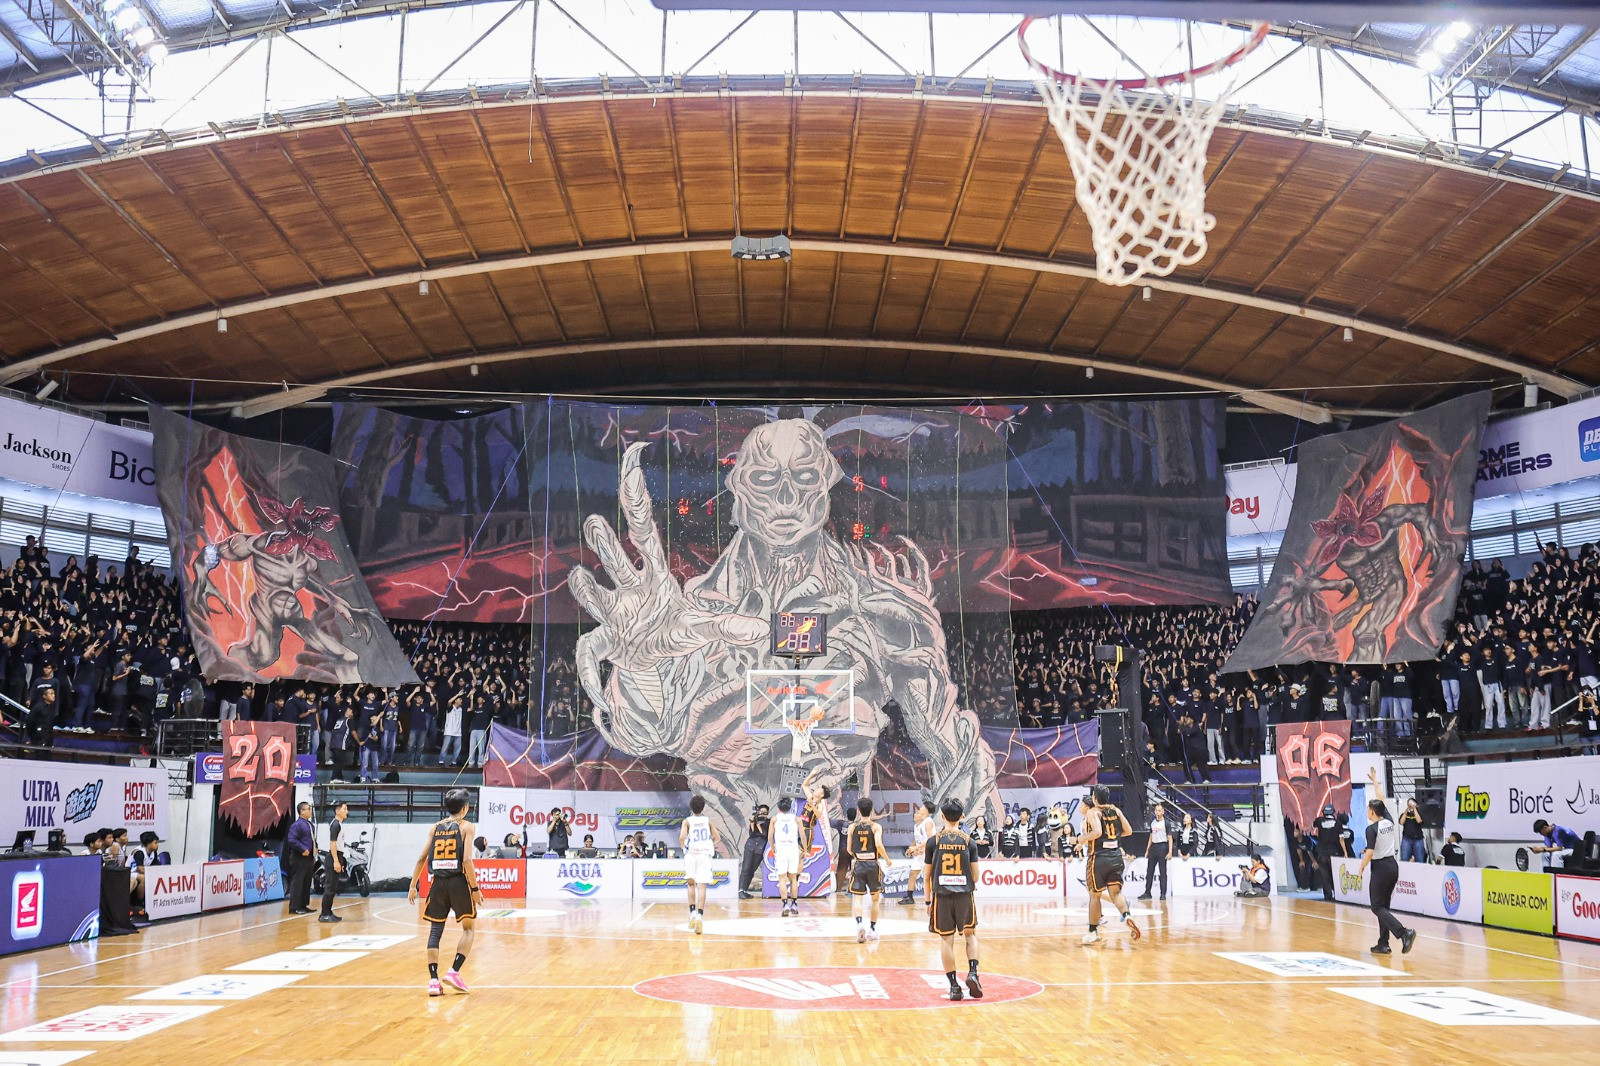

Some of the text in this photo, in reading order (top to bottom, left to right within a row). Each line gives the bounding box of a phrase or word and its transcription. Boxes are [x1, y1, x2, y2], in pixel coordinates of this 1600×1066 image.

[3, 432, 72, 464] Jackson
[51, 463, 71, 472] SHOES
[228, 734, 292, 783] 20
[1280, 732, 1346, 778] 06
[23, 780, 60, 802] ULTRA
[124, 782, 155, 802] HOT IN
[1457, 785, 1490, 814] Taro
[1509, 786, 1554, 814] Bioré
[25, 806, 56, 827] MILK
[124, 804, 155, 821] CREAM
[692, 828, 708, 842] 30
[783, 823, 789, 834] 4
[434, 838, 457, 859] 22
[859, 837, 868, 851] 7
[557, 863, 602, 881] AQUA
[942, 853, 963, 875] 21
[154, 875, 196, 895] AHM
[171, 897, 184, 906] Honda
[1487, 891, 1548, 910] AZAWEAR.COM
